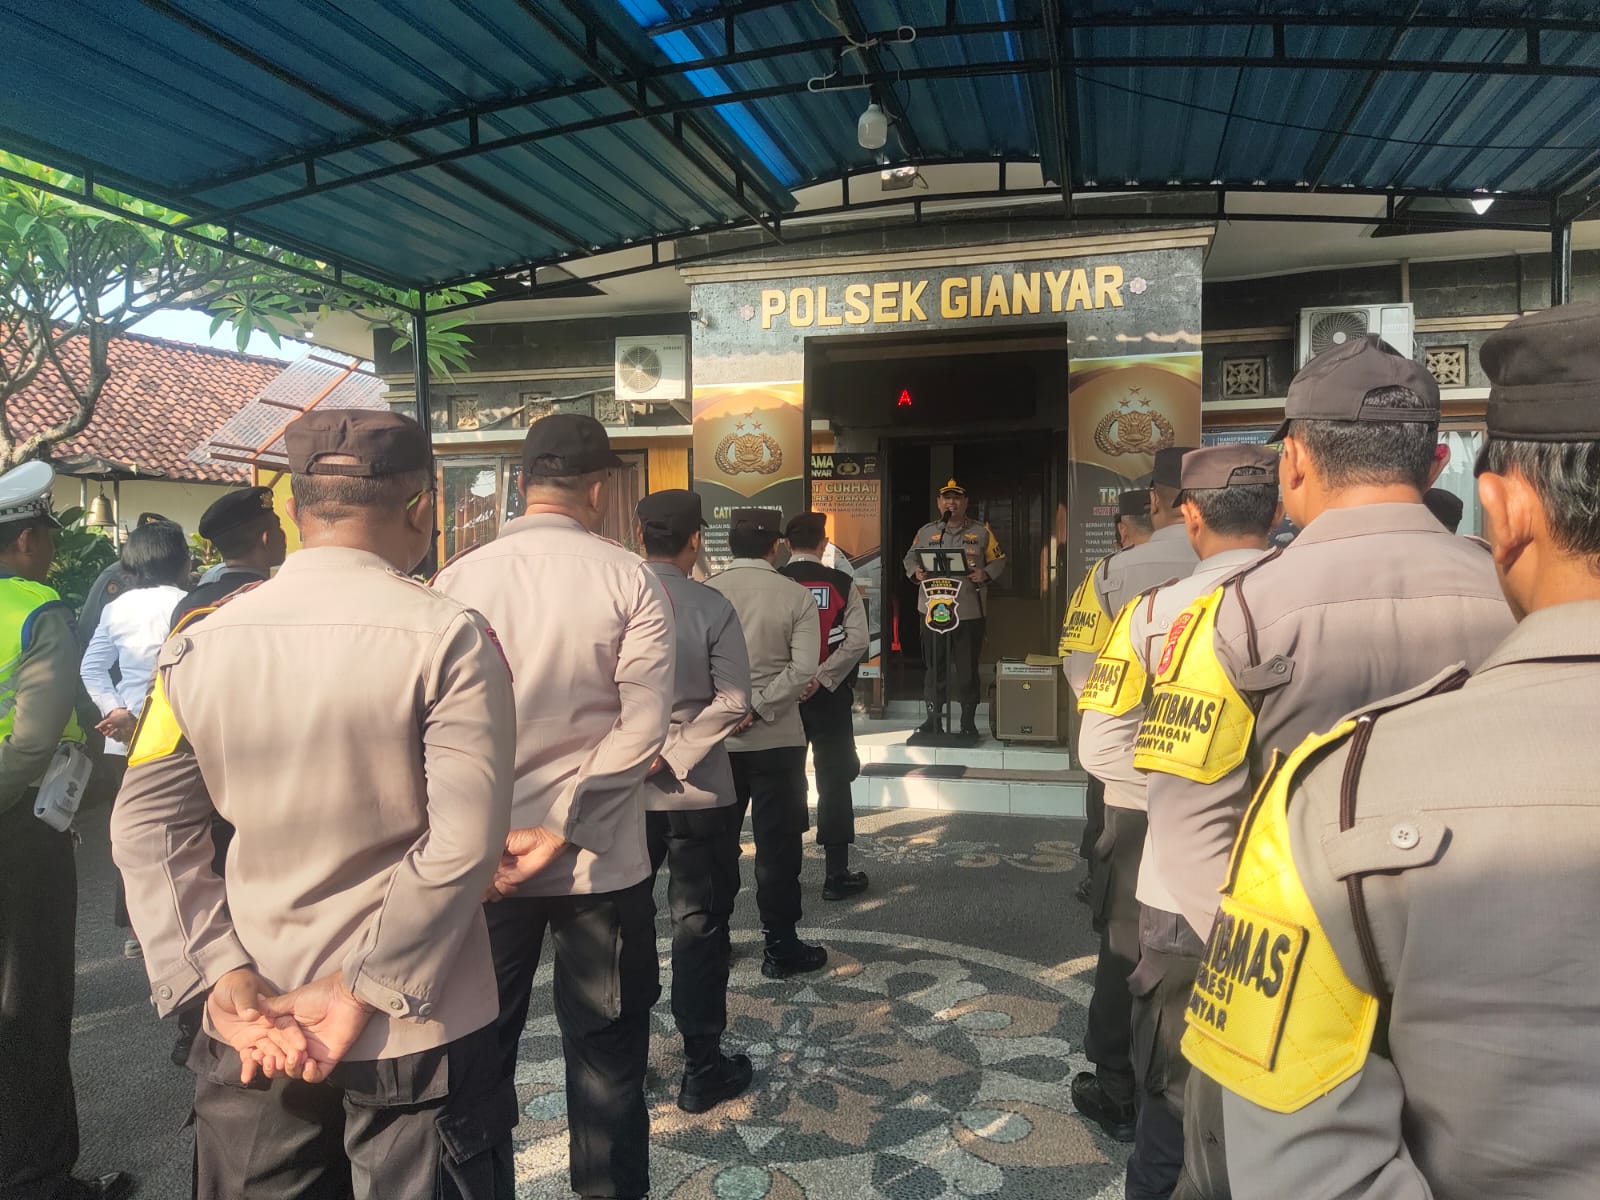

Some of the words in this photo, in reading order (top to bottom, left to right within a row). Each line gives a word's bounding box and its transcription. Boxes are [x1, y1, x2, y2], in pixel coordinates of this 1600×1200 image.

[761, 280, 929, 329] POLSEK
[940, 265, 1124, 319] GIANYAR
[898, 389, 912, 406] A
[825, 482, 877, 493] CURHAT
